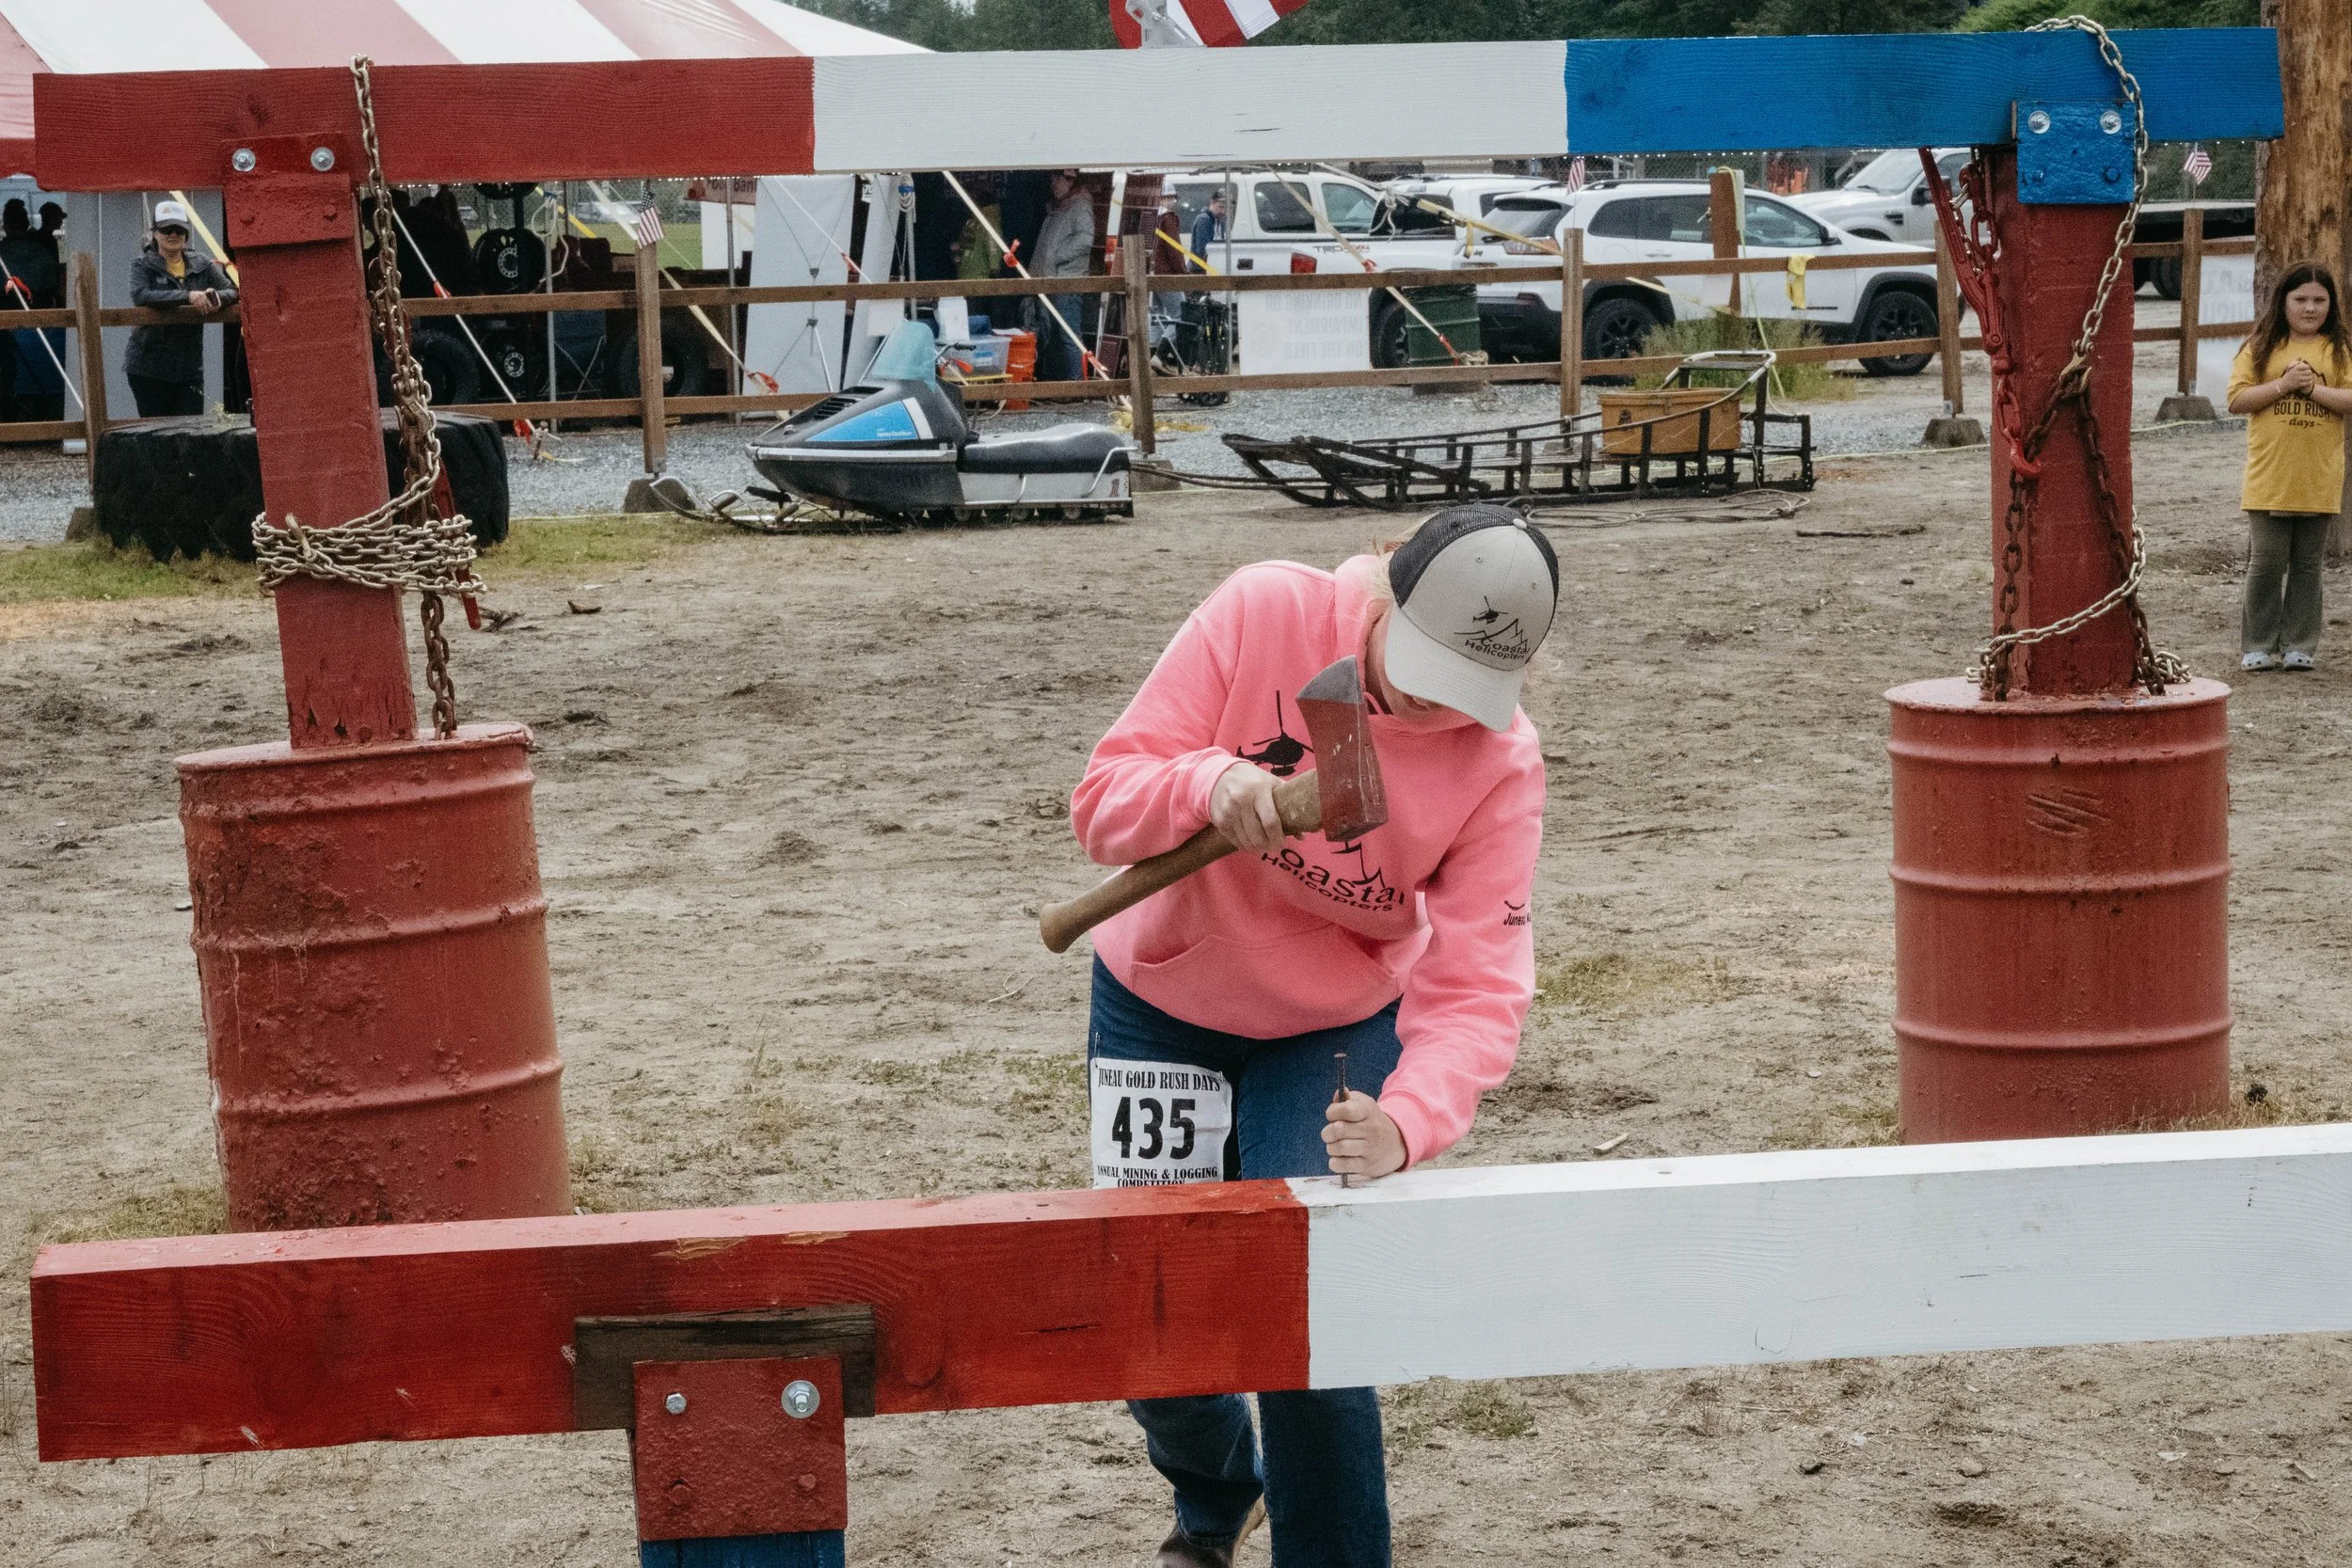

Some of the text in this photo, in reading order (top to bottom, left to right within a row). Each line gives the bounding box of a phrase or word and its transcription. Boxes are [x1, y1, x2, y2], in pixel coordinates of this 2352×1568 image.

[2274, 402, 2330, 419] GOLD RUSH
[2289, 417, 2315, 429] days
[1261, 852, 1393, 912] Helicopters
[1279, 847, 1405, 905] oastal
[1098, 1068, 1221, 1092] JUNEAU GOLD RUSH DAYS
[1112, 1096, 1196, 1160] 435
[1097, 1164, 1218, 1180] ANNUAL MINING & LOGGING
